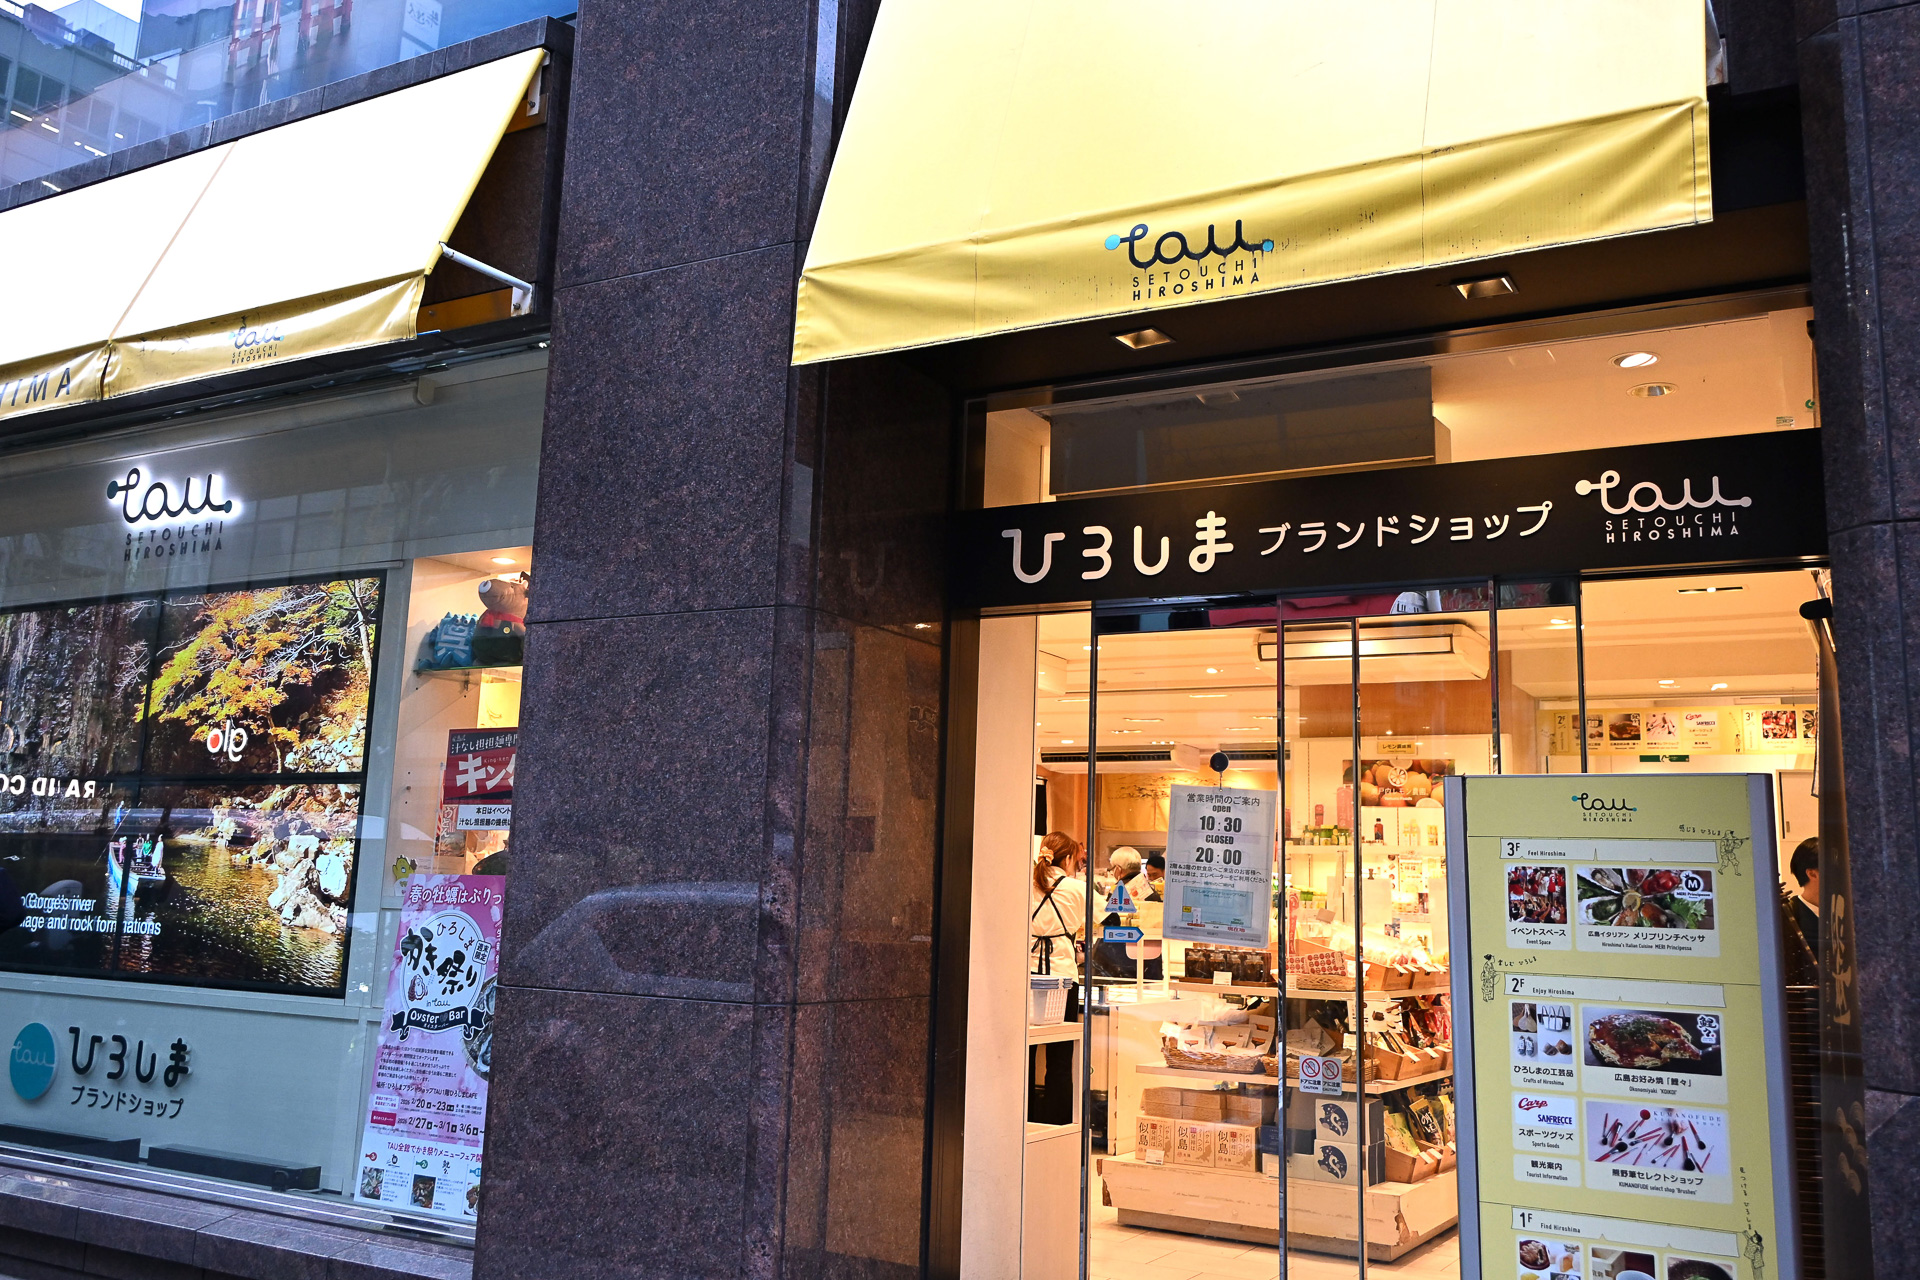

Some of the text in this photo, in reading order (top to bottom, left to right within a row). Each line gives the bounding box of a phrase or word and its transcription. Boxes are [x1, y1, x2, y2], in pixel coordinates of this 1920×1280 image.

[1105, 219, 1274, 269] tau
[1132, 257, 1259, 288] SETOUCHI
[1132, 272, 1260, 301] HIROSHIMA
[228, 325, 285, 350] tau
[231, 351, 279, 365] HIROSHIMA
[232, 344, 278, 359] SETOUCHI
[0, 367, 71, 408] IMA
[106, 467, 233, 524] tau
[1574, 469, 1753, 516] tau
[1605, 511, 1736, 531] SETOUCHI
[126, 520, 223, 546] SETOUCHI
[1001, 500, 1554, 584] ひろしま ブランドショップ
[1606, 525, 1739, 544] HIROSHIMA
[124, 537, 223, 562] HIROSHIMA
[1187, 792, 1260, 807] 営業時間のご案内
[1212, 804, 1231, 813] open
[1571, 792, 1637, 811] tau
[1199, 815, 1243, 833] 10:30
[1205, 834, 1234, 845] CLOSED
[1195, 846, 1242, 866] 20:00
[1506, 841, 1521, 857] 3F
[47, 913, 68, 931] and
[70, 915, 93, 932] rock
[1510, 927, 1567, 937] イベントスペース
[1511, 977, 1525, 993] 2F
[1532, 987, 1575, 996] Enjoy Hiroshima
[410, 1010, 466, 1024] Oyster Bar
[68, 1026, 191, 1088] ひろしま
[1513, 1065, 1574, 1078] ひろしまの工芸品
[70, 1085, 185, 1119] ブランドショップ
[1518, 1097, 1549, 1111] Carp
[1537, 1113, 1573, 1125] SANFRECCE
[1139, 1121, 1149, 1147] 似島
[1177, 1125, 1189, 1151] 似島
[1217, 1130, 1229, 1155] 似島
[1518, 1128, 1574, 1141] スポーツグッズ
[1531, 1140, 1546, 1148] Sports
[1530, 1159, 1563, 1171] 観光案内
[1526, 1170, 1568, 1181] Tourist Information
[1611, 1168, 1704, 1186] 熊野筆セレクトショップ
[1618, 1181, 1649, 1191] KUMANOFUDE
[1649, 1184, 1664, 1192] select
[1519, 1211, 1533, 1228] 1F
[1540, 1222, 1581, 1234] Find Hiroshima
